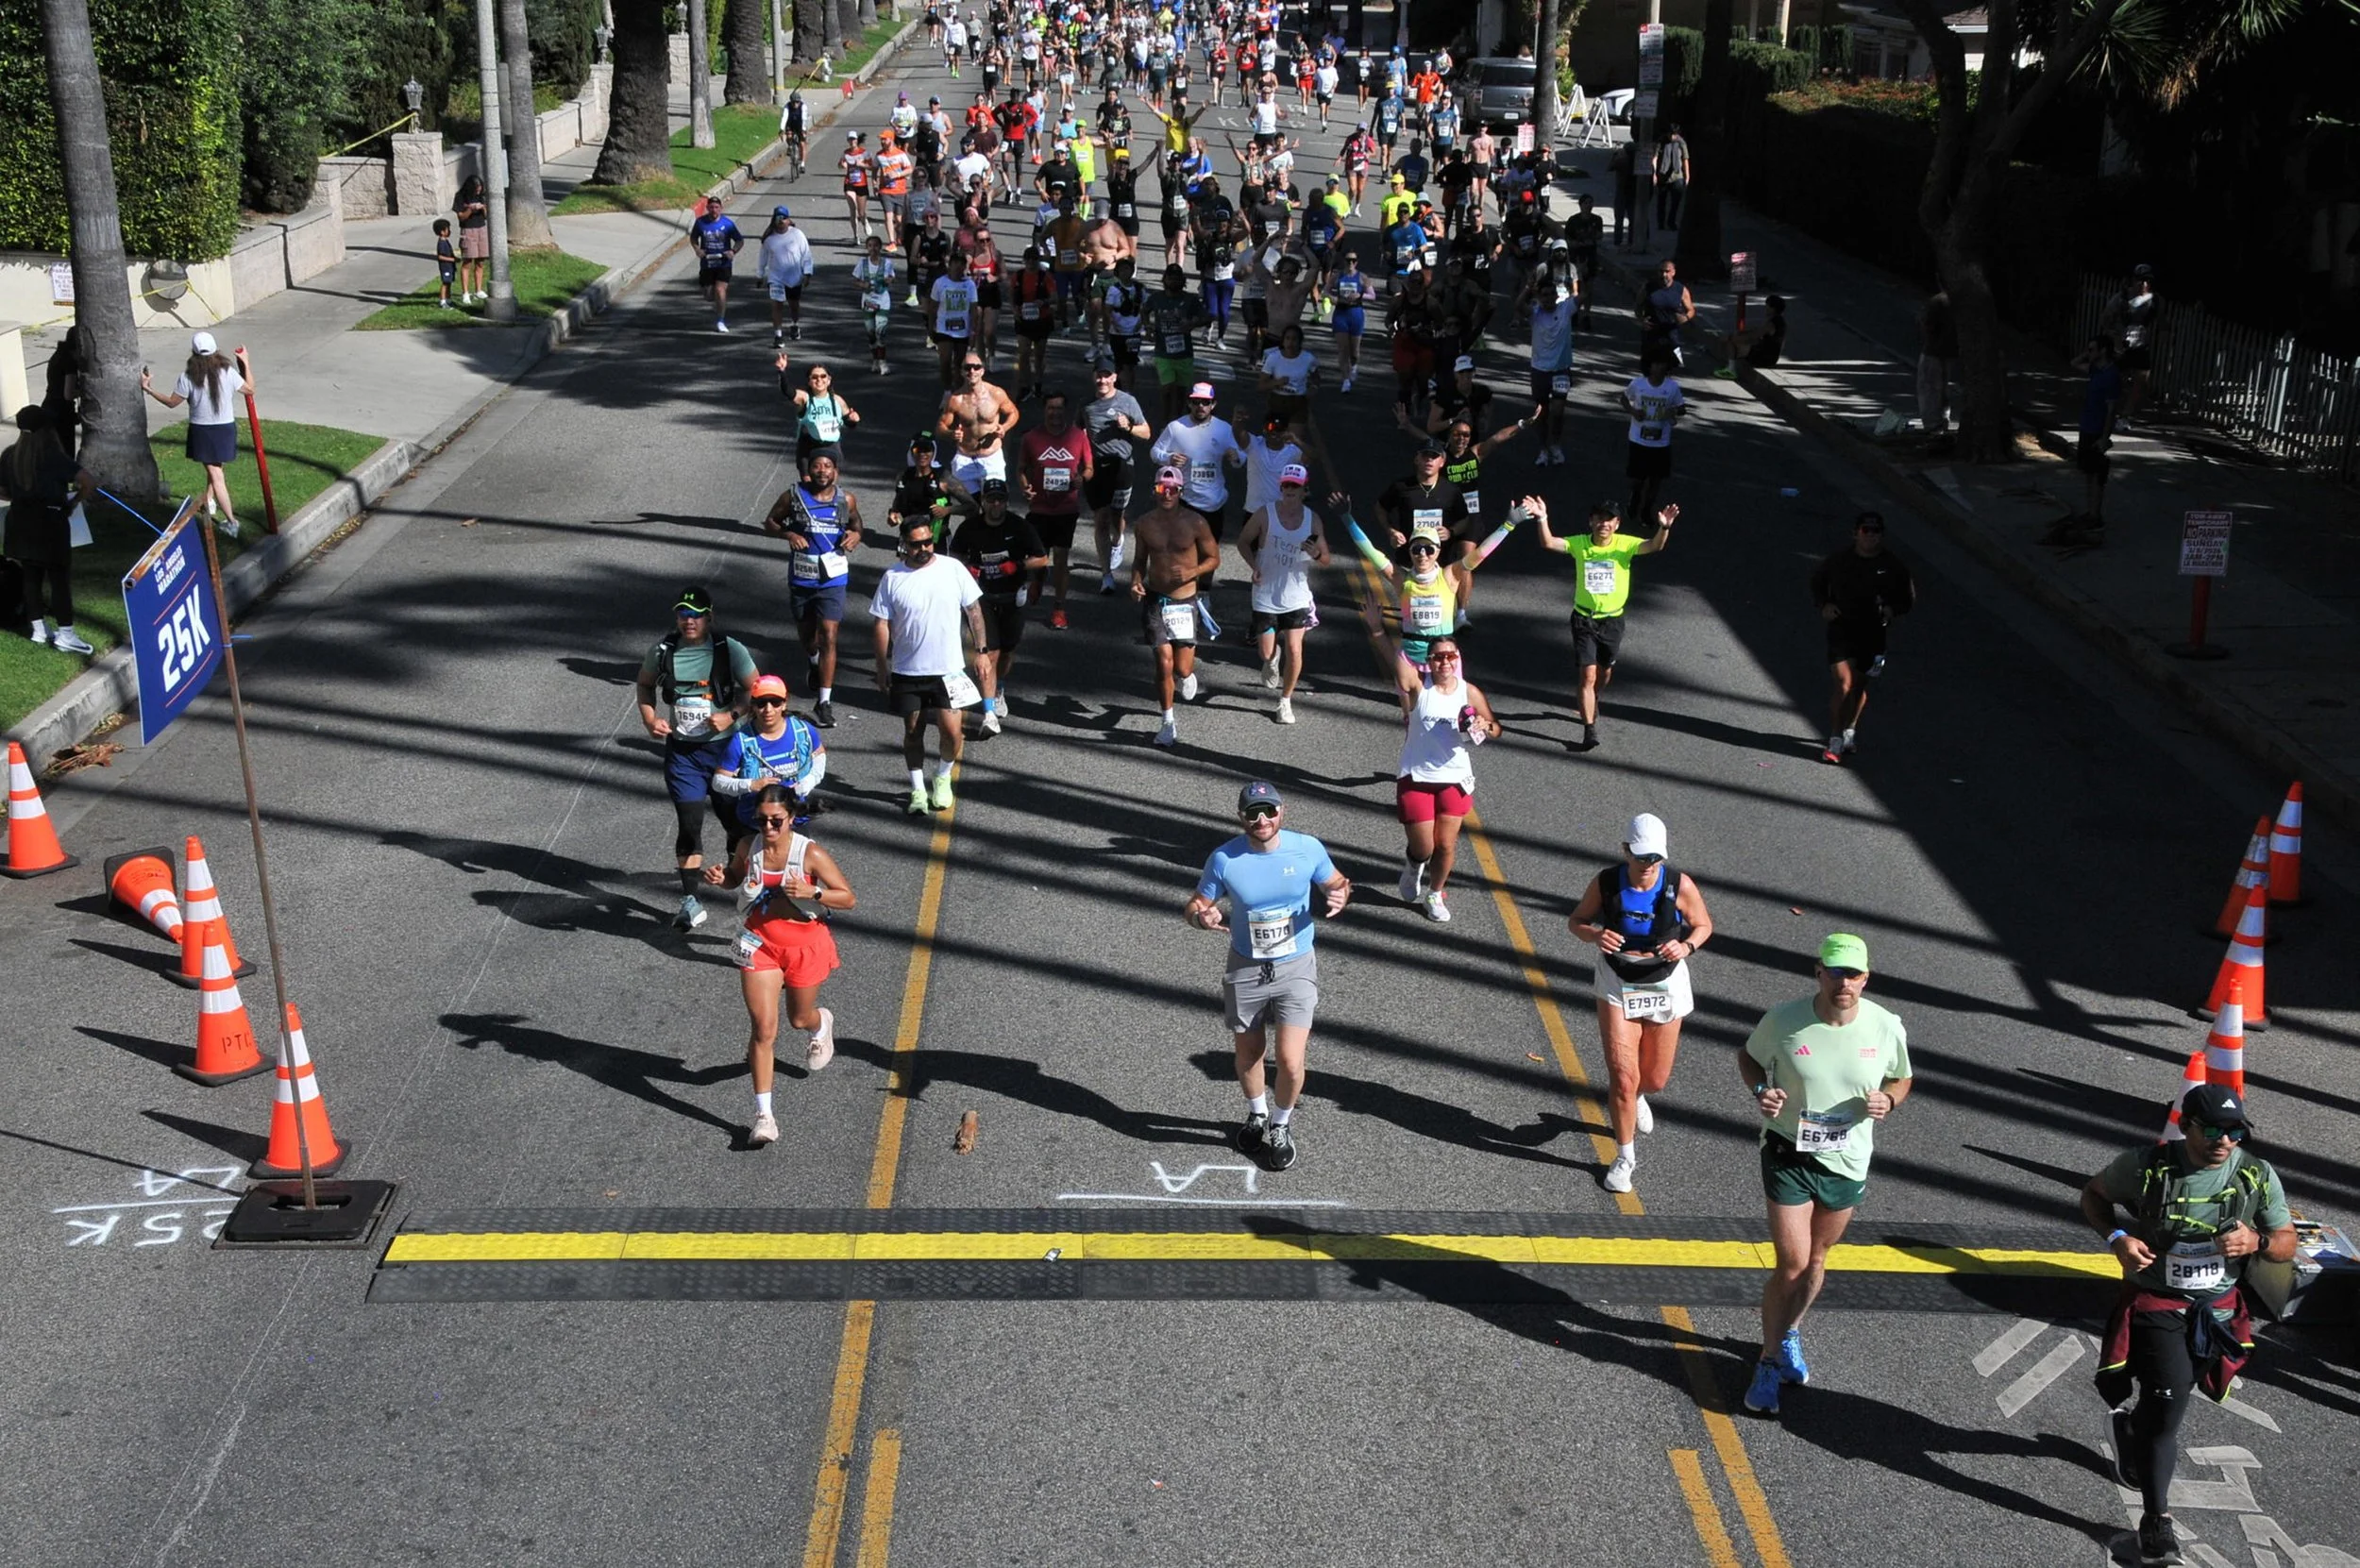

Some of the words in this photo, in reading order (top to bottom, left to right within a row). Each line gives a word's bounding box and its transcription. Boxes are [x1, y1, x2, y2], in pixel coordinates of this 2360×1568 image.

[2185, 528, 2197, 538] NO
[2198, 527, 2228, 538] PARKING
[1412, 611, 1440, 620] E8819
[158, 583, 211, 693] 25K
[678, 711, 708, 721] 16945
[1255, 924, 1290, 939] E6170
[1628, 996, 1666, 1009] E7972
[1802, 1129, 1847, 1142] E6768
[2172, 1262, 2218, 1278] 28118
